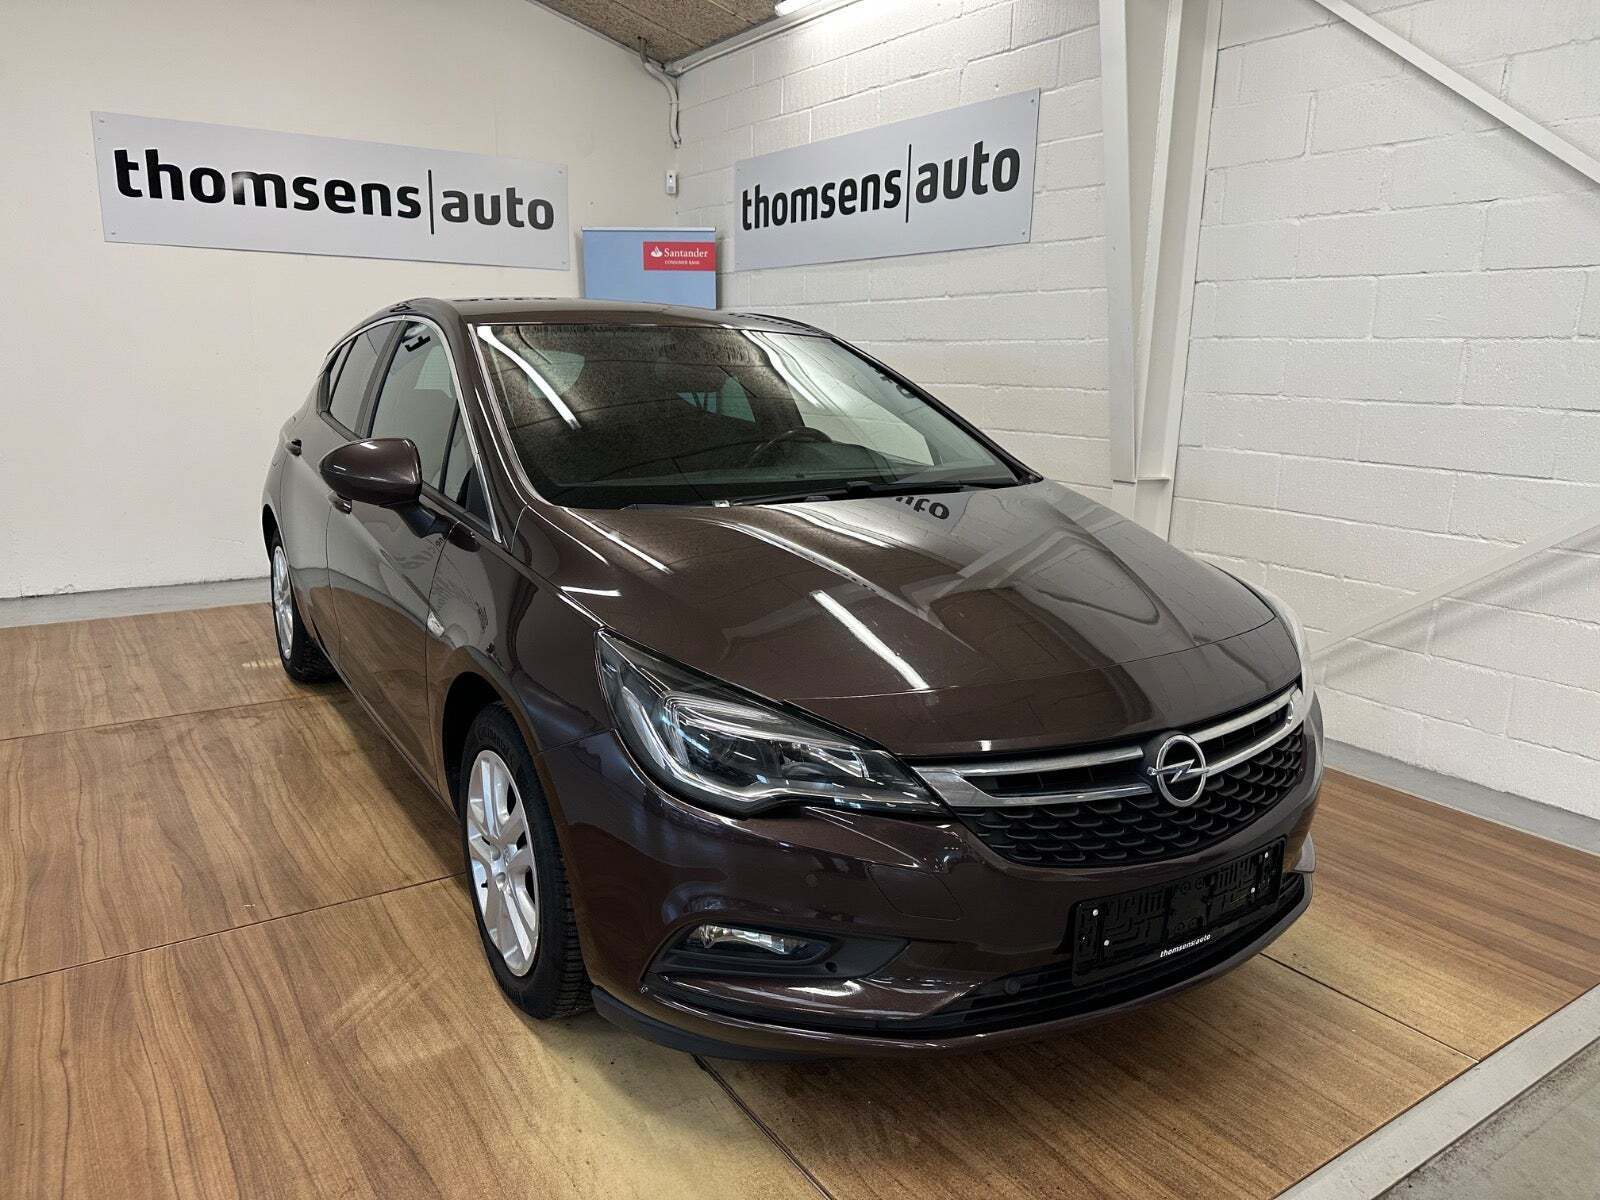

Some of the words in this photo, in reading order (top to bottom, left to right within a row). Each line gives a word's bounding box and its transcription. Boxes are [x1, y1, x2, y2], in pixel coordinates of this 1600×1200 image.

[113, 148, 422, 220] thomsens
[441, 187, 555, 231] auto
[742, 169, 902, 231] thomsens
[915, 140, 1021, 204] auto
[664, 247, 709, 258] Santander
